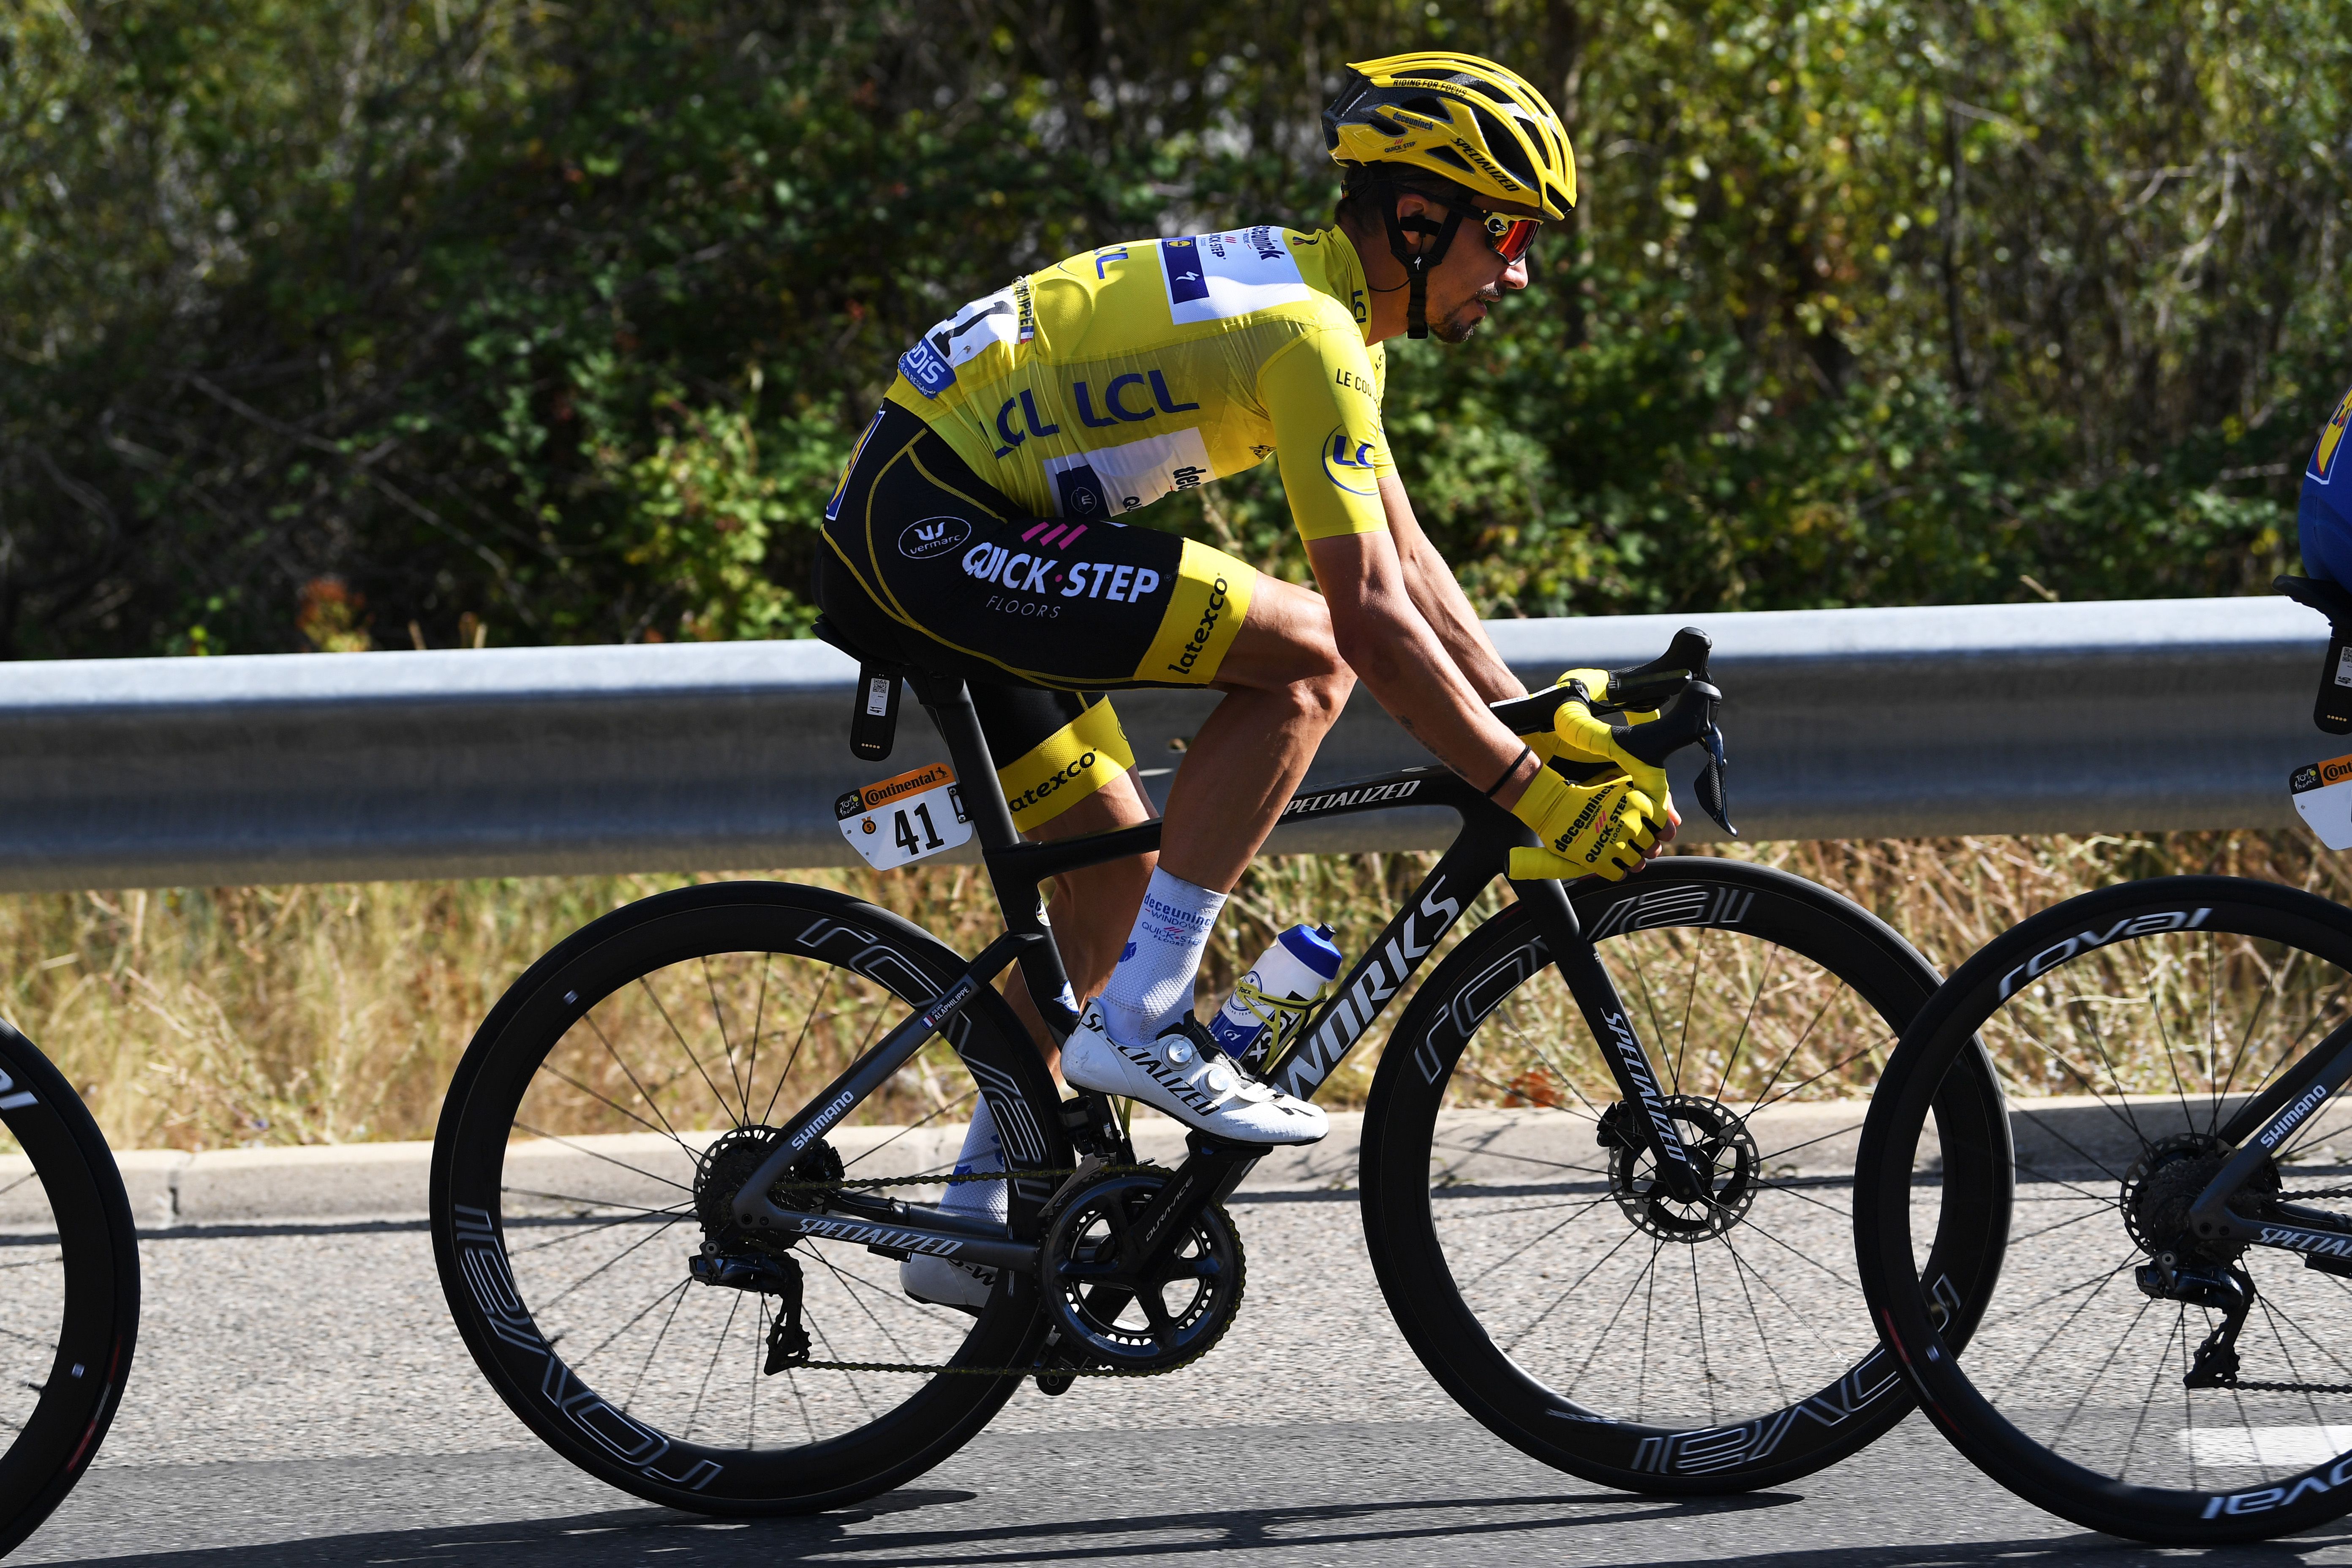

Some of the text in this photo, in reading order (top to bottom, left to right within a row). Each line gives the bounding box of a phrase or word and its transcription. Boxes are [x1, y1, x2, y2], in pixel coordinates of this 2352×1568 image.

[1422, 80, 1439, 88] FOR
[1440, 82, 1467, 97] FOCUS
[1392, 111, 1434, 131] deceuninck
[1450, 137, 1520, 192] SPECIALIZED
[1336, 368, 1352, 387] LE
[1073, 370, 1200, 428] LCL
[909, 535, 961, 555] vermarc
[986, 595, 1061, 619] FLOORS
[1167, 577, 1228, 675] latexco
[2338, 676, 2351, 684] 46
[869, 706, 882, 714] 41
[865, 770, 936, 806] Continental
[1009, 751, 1096, 815] atexco
[1282, 780, 1421, 816] PECIALIZED
[894, 802, 945, 856] 41
[1554, 784, 1618, 852] deceuninck
[1584, 804, 1603, 830] WINDOWS
[1609, 819, 1625, 845] FLOORS
[1152, 910, 1204, 934] WINDOWS
[1154, 935, 1184, 946] FLOORS
[1998, 908, 2213, 1002] roval
[934, 986, 970, 1021] ALAPHILIPPE
[1239, 986, 1252, 995] Tacx
[931, 1003, 943, 1015] JULIAN
[1600, 1007, 1687, 1162] SPECIALIZED
[791, 1090, 854, 1151] SHIMANO
[2260, 1084, 2327, 1149] SHIMANO
[1145, 1175, 1193, 1242] DURA-ACE
[790, 1217, 964, 1257] SPECIALIZED
